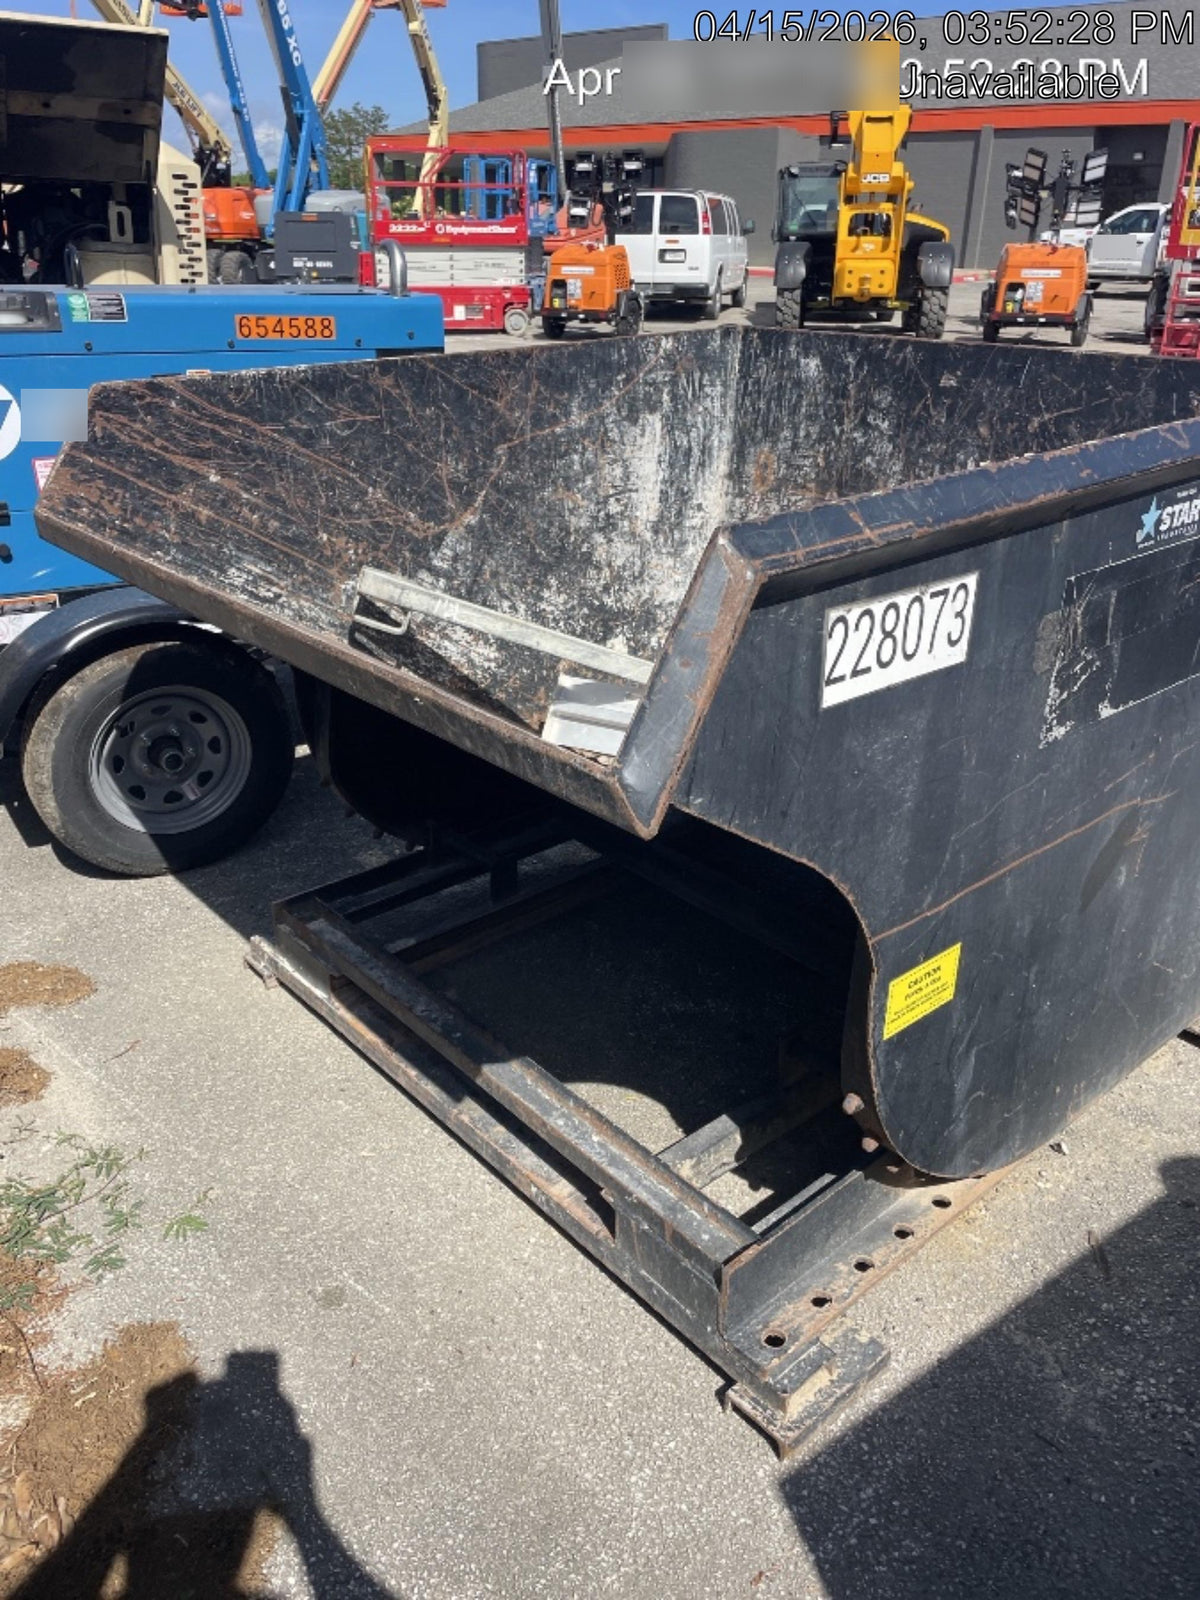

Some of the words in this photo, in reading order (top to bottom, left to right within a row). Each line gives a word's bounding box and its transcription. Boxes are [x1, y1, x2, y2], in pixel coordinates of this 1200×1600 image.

[239, 315, 333, 339] 654588
[1159, 499, 1200, 531] STAR
[824, 582, 970, 687] 228073
